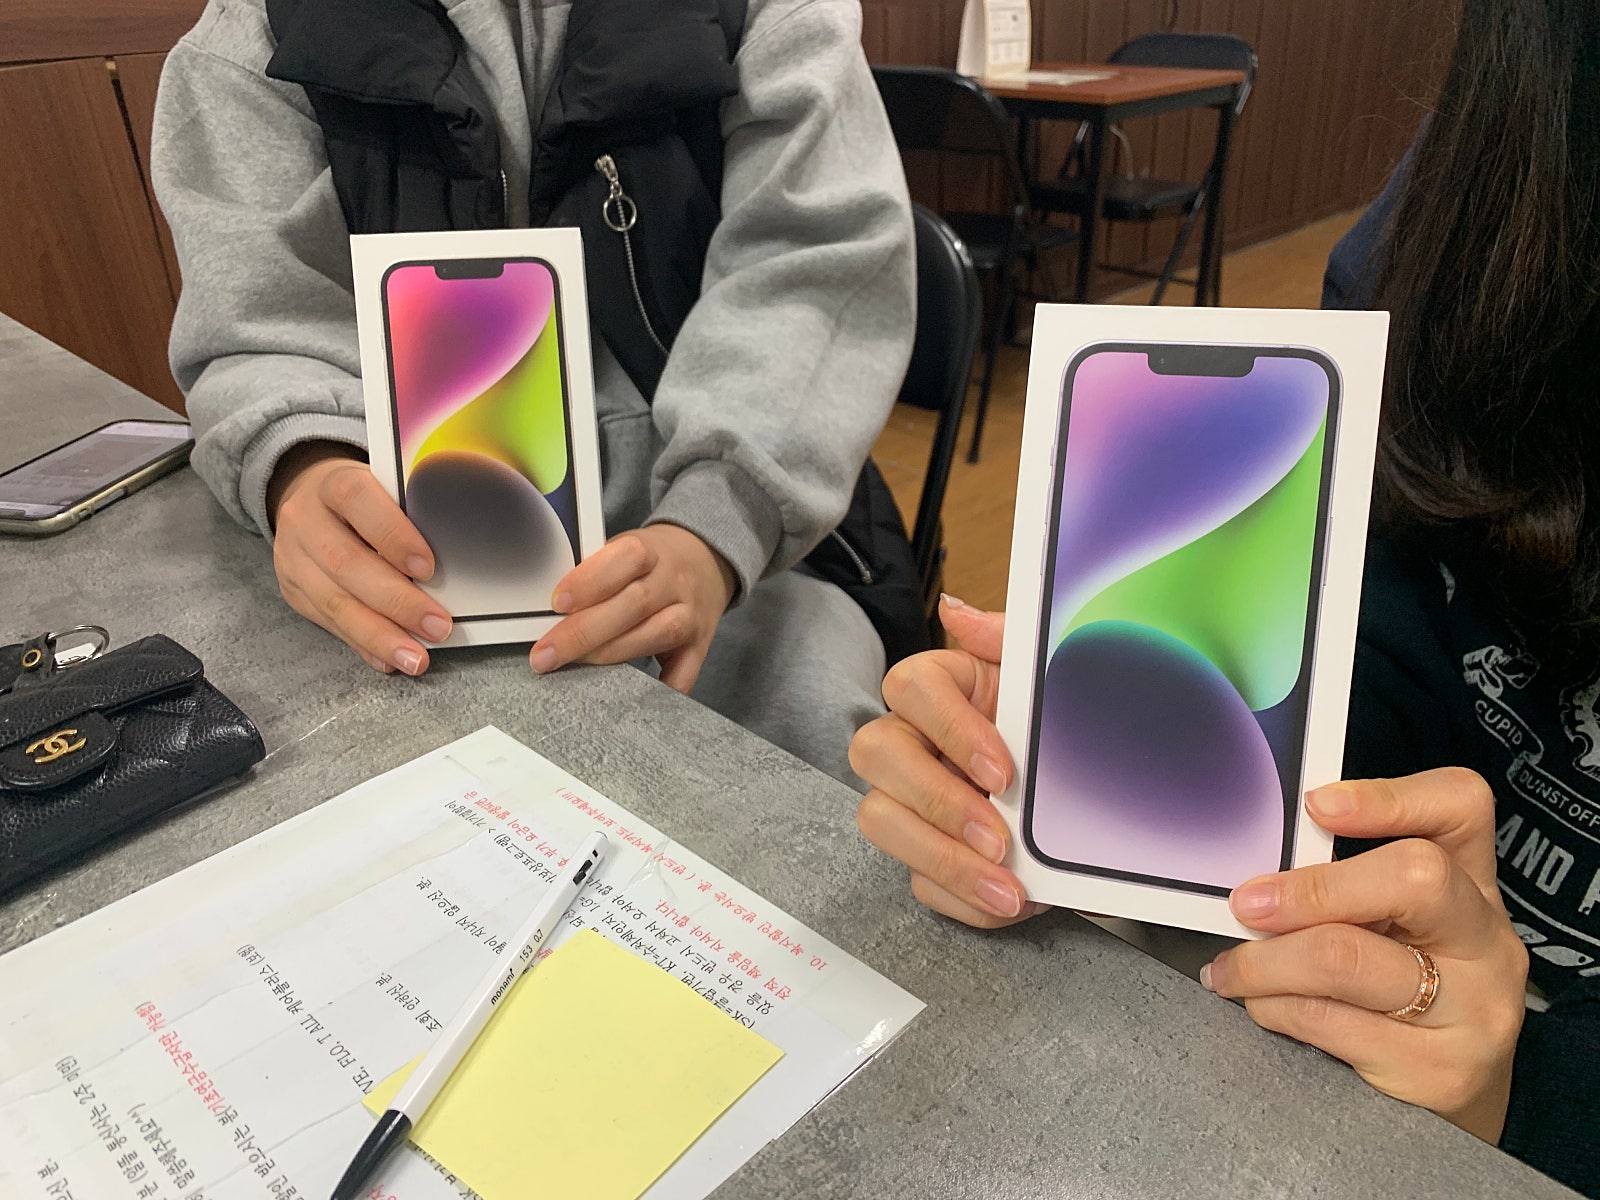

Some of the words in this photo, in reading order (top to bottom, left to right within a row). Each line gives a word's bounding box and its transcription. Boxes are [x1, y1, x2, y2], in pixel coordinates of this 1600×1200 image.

[1475, 699, 1523, 745] CUPID
[506, 818, 538, 842] 요금이
[653, 851, 687, 875] 반드시
[416, 876, 432, 891] 분.
[426, 889, 461, 917] 않으신
[611, 894, 647, 920] 오셔야
[655, 898, 690, 928] 합니다.
[714, 891, 757, 923] 받으시는
[455, 915, 486, 938] 지나지
[689, 925, 725, 952] 지셔야
[756, 921, 804, 956] 복지할인
[236, 943, 265, 966] (보험)
[490, 967, 515, 1006] monami
[519, 944, 540, 962] 153
[533, 928, 550, 943] 0.7
[679, 944, 717, 974] 반드시
[727, 950, 762, 979] 책임을
[809, 955, 827, 971] 10.
[259, 963, 304, 1015] 케어플러스
[375, 972, 393, 987] 분.
[718, 973, 743, 994] 경우
[763, 976, 791, 1000] 전적
[385, 982, 421, 1011] 안하신
[746, 992, 775, 1015] 있을
[299, 1013, 324, 1034] ALL
[414, 1009, 443, 1033] 조회
[316, 1033, 332, 1045] T
[72, 1083, 96, 1105] 2주
[89, 1103, 127, 1152] 통신사는
[233, 1124, 276, 1178] 받으시는
